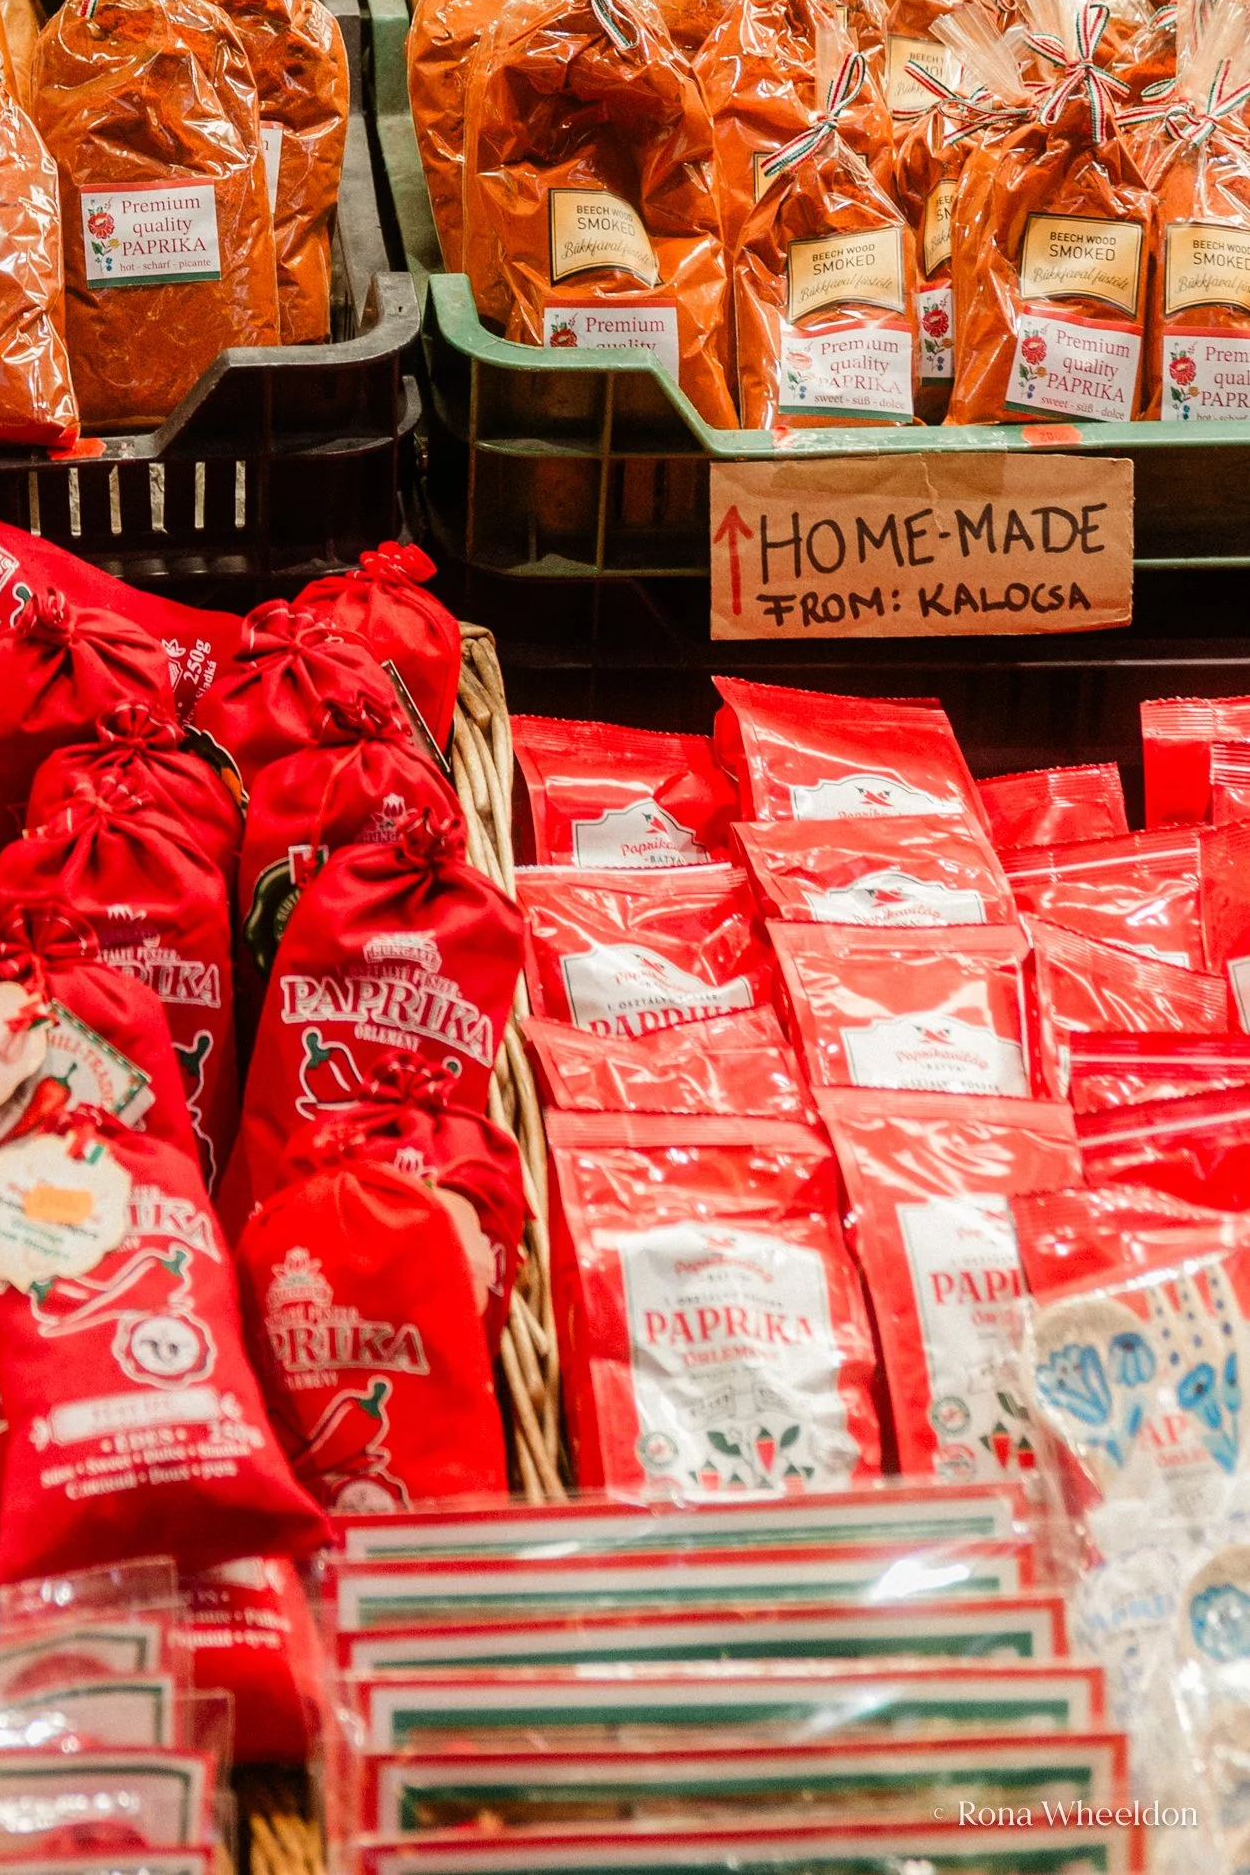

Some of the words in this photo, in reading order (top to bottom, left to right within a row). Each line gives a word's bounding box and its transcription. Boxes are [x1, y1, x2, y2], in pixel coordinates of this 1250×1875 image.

[121, 197, 200, 214] Premium
[576, 205, 610, 216] BEECH
[132, 217, 193, 235] quality
[576, 217, 636, 237] SMOKED
[121, 236, 207, 257] PAPRIKA
[1050, 231, 1084, 244] BEECH
[1086, 235, 1117, 246] WOOD
[1193, 240, 1226, 252] BEECH
[812, 250, 845, 263] BEECH
[846, 244, 875, 255] WOOD
[1049, 245, 1116, 262] SMOKED
[119, 263, 135, 273] hot
[142, 260, 171, 272] scharf
[178, 258, 211, 270] picante
[813, 253, 876, 276] SMOKED
[586, 316, 666, 333] Premium
[820, 340, 899, 355] Premium
[1056, 329, 1131, 358] Premium
[1205, 345, 1250, 364] Prem
[830, 355, 890, 375] quality
[1062, 356, 1120, 382] quality
[1046, 372, 1126, 404] PAPRIKA
[814, 393, 844, 404] sweet
[852, 395, 871, 406] süß
[1040, 395, 1069, 410] sweet
[1076, 402, 1095, 414] süß
[1101, 407, 1126, 422] dolce
[760, 503, 1108, 585] HOME-MADE
[756, 584, 901, 627] FROM:
[918, 581, 1092, 618] KALOCSA
[280, 975, 493, 1070] PAPRIKA
[643, 1304, 817, 1348] PAPRIKA
